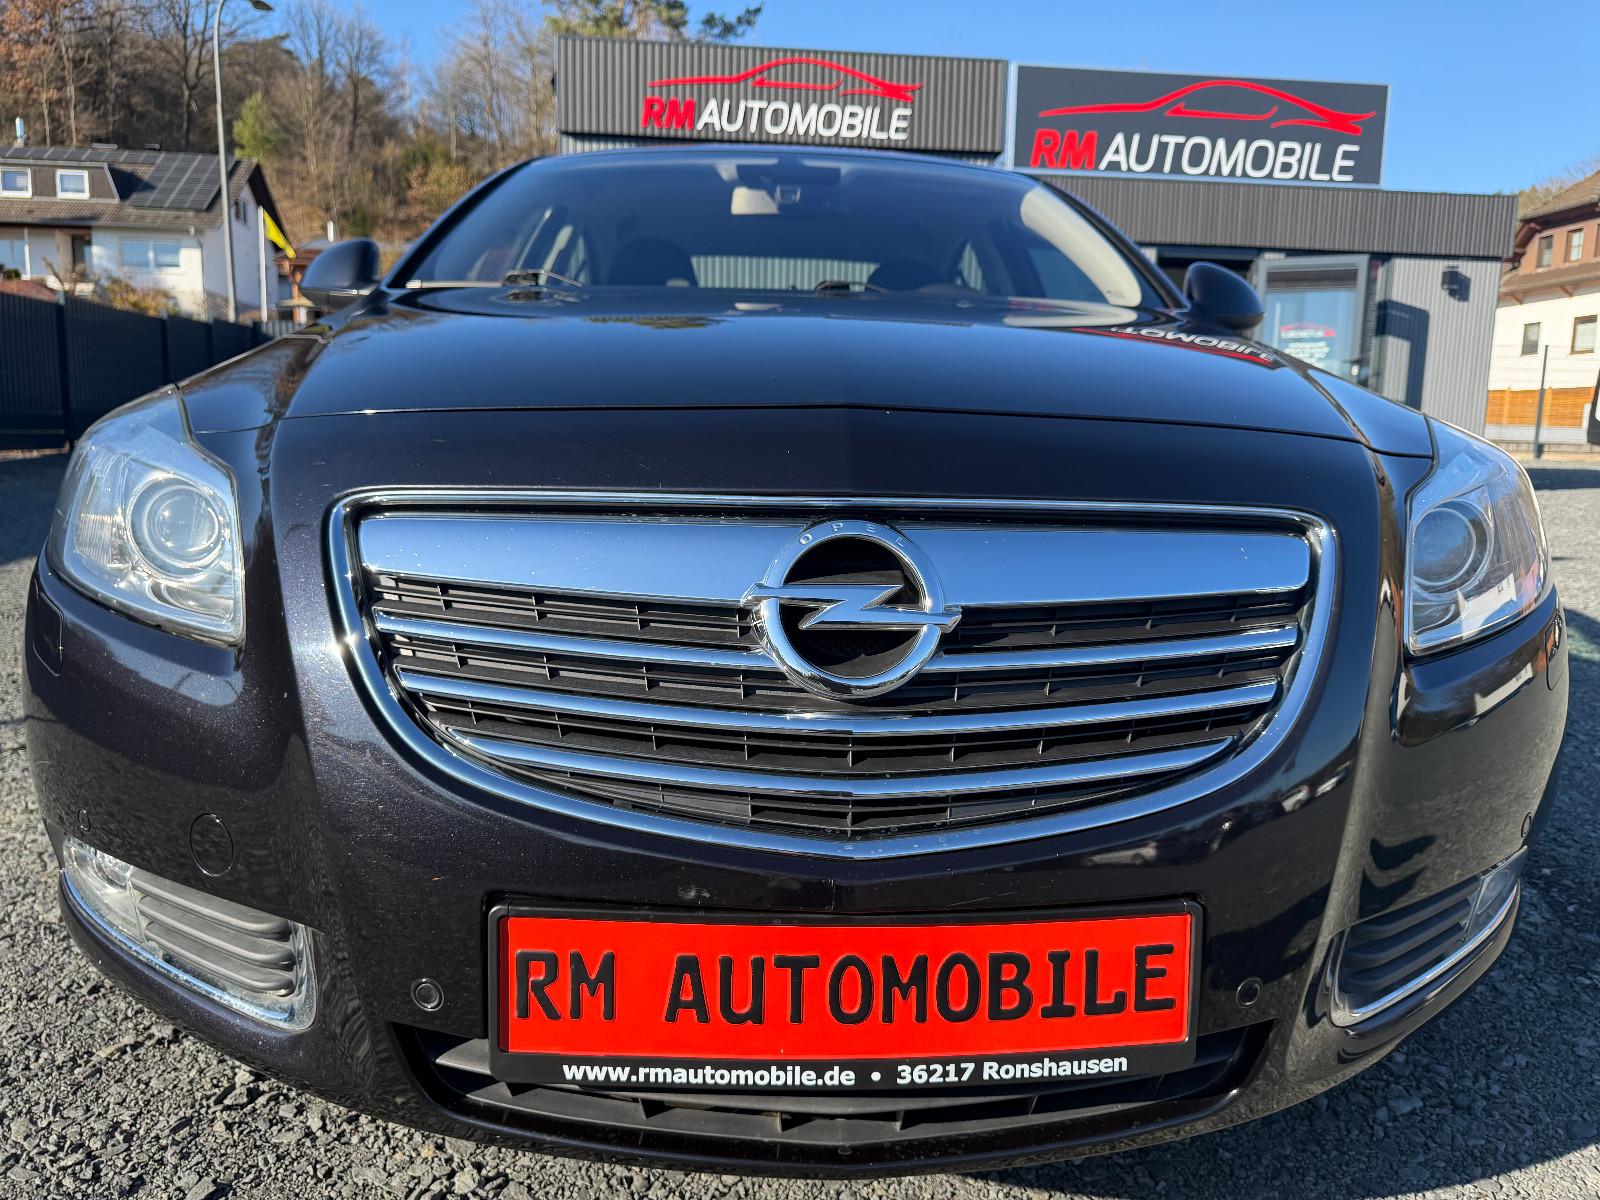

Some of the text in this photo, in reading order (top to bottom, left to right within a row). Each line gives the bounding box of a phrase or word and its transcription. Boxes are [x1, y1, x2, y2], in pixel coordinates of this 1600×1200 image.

[640, 96, 913, 140] RM AUTOMOBILE
[1030, 128, 1361, 182] RM AUTOMOBILE
[799, 522, 905, 548] OPEL
[514, 943, 1176, 1025] RM AUTOMOBILE
[562, 1056, 1128, 1087] www.rmautomobile.de 36217 Ronshausen
